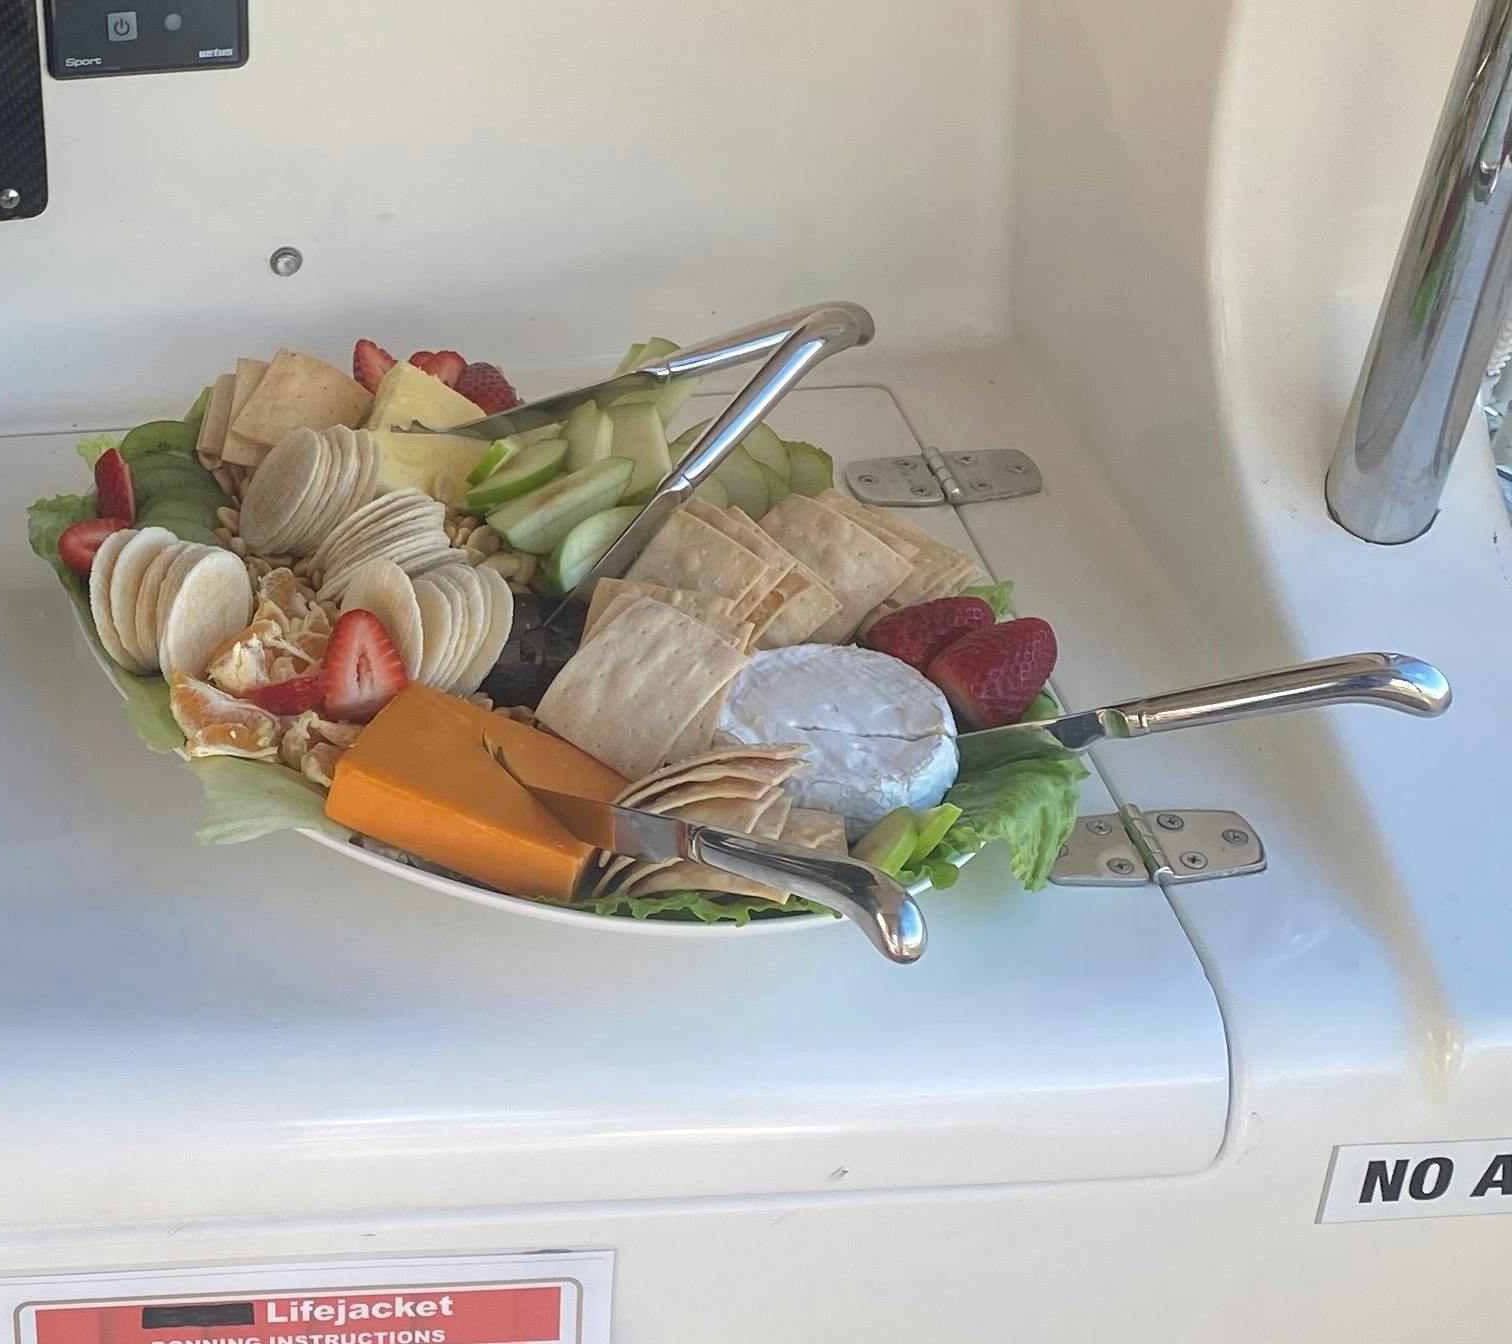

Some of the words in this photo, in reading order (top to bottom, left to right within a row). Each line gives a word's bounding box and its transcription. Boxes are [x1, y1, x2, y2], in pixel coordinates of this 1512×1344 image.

[65, 57, 102, 68] Sport
[1359, 1156, 1454, 1204] NO
[266, 1295, 454, 1326] Lifejacket
